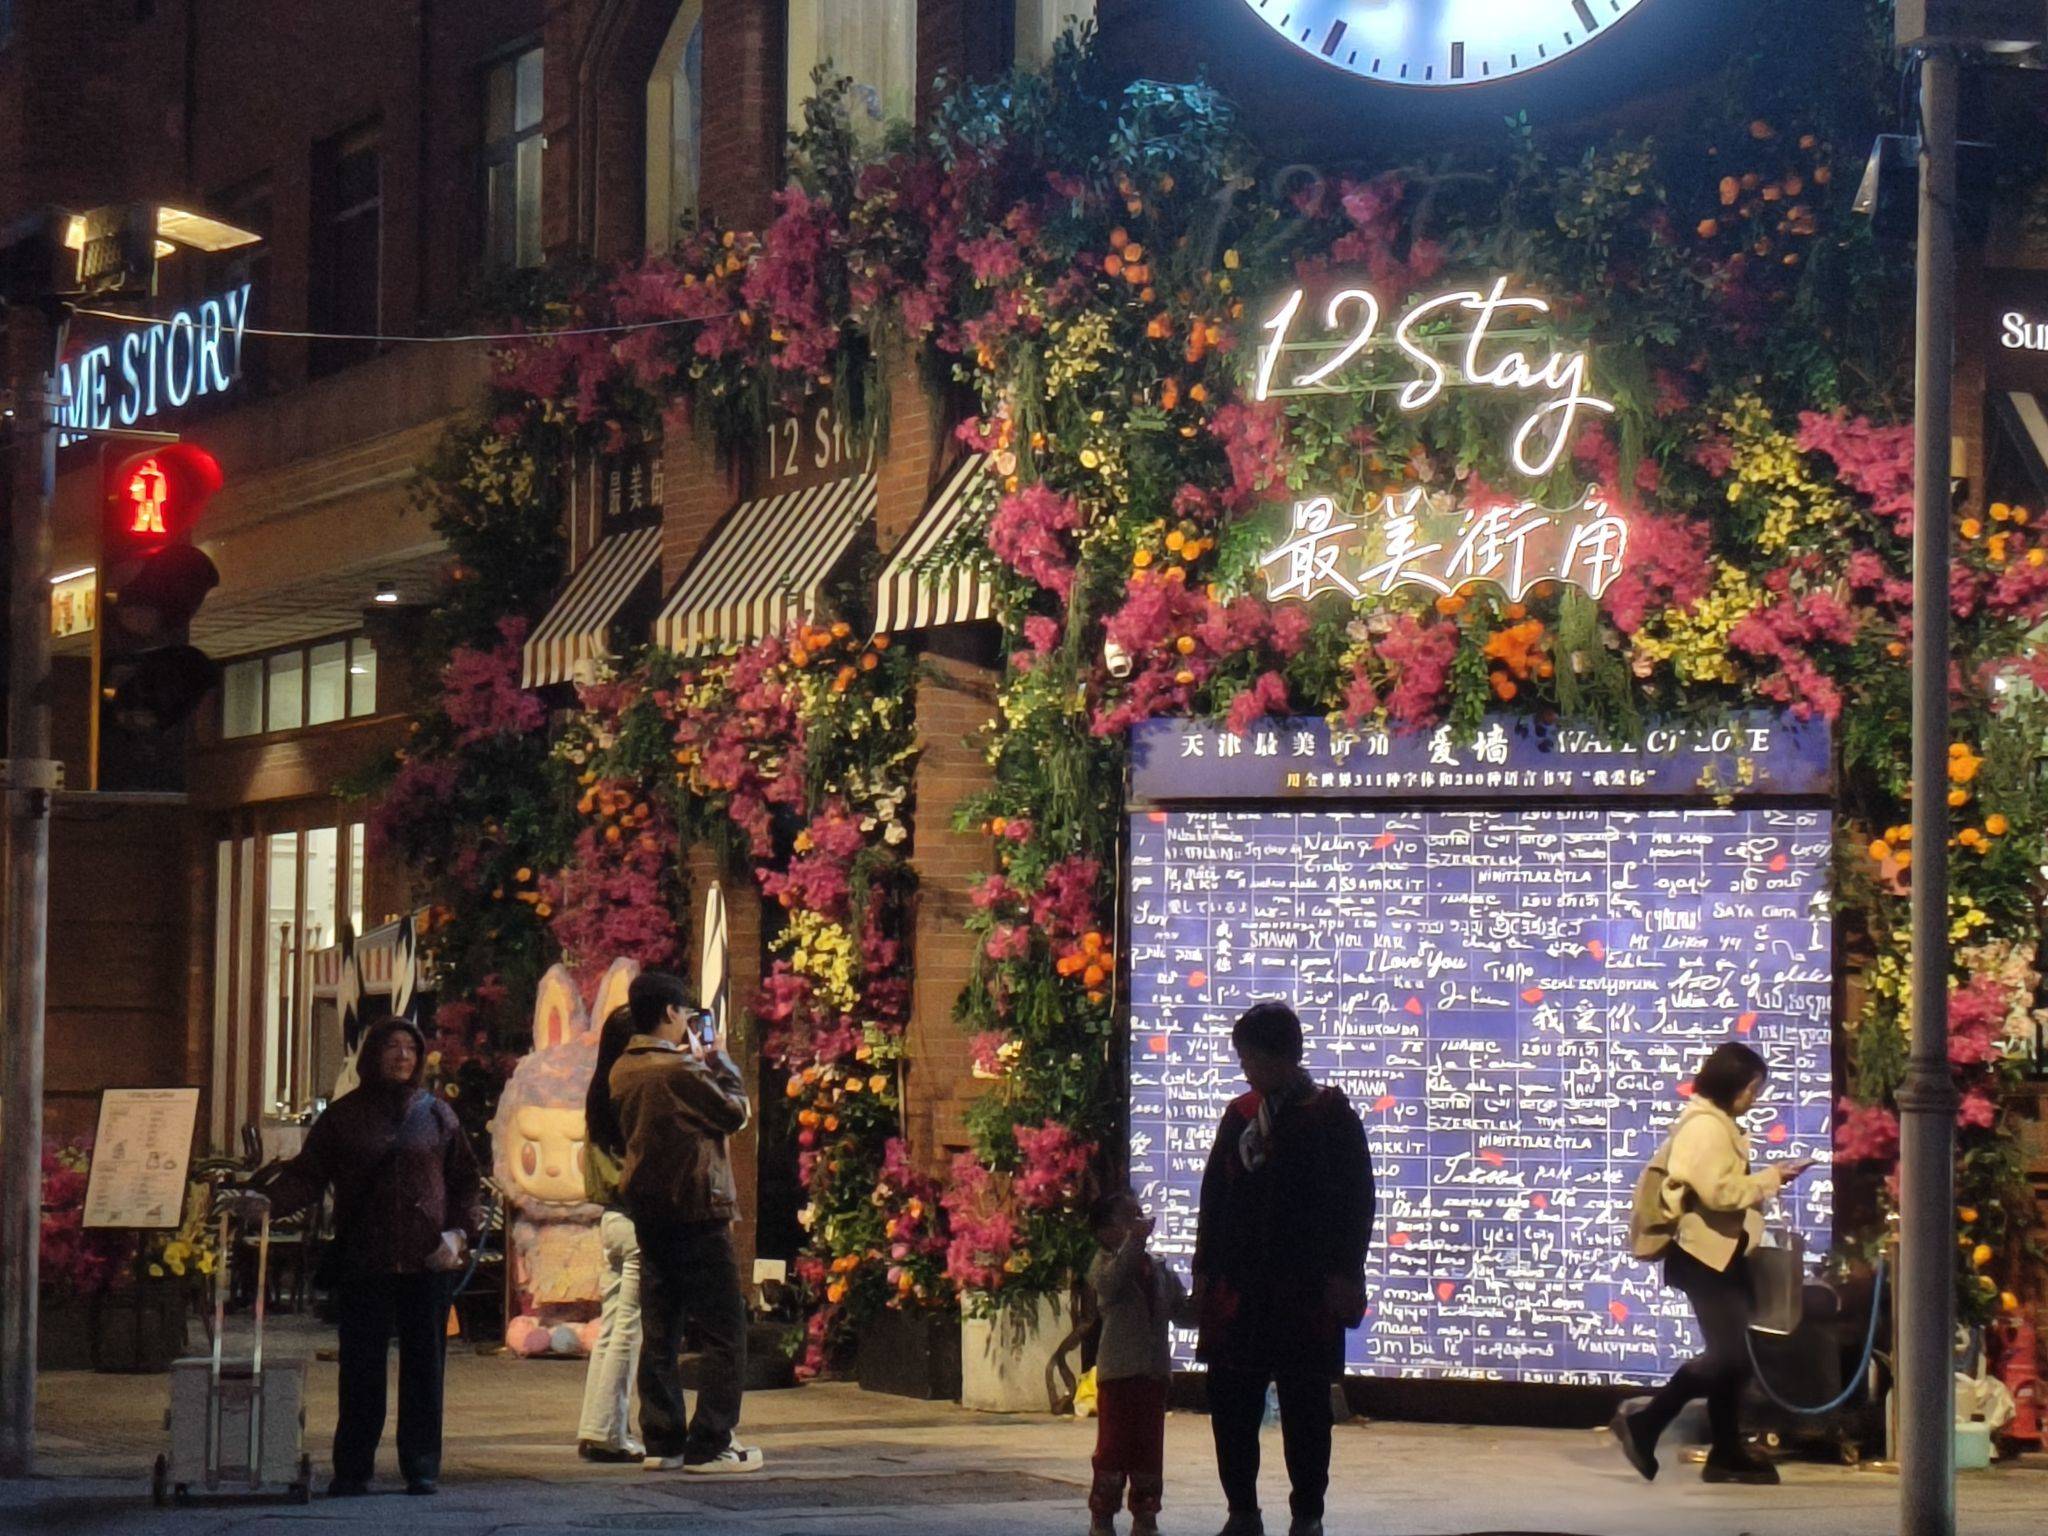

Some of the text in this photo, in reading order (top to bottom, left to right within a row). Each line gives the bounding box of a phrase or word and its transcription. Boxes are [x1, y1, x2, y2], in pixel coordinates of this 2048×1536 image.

[119, 283, 251, 426] STORY
[2000, 314, 2048, 352] Su
[1395, 276, 1616, 477] Stay
[767, 417, 799, 480] 12
[1260, 487, 1629, 602] 最美街角
[1428, 723, 1509, 767] 爱墙
[1365, 950, 1468, 978] I Love You
